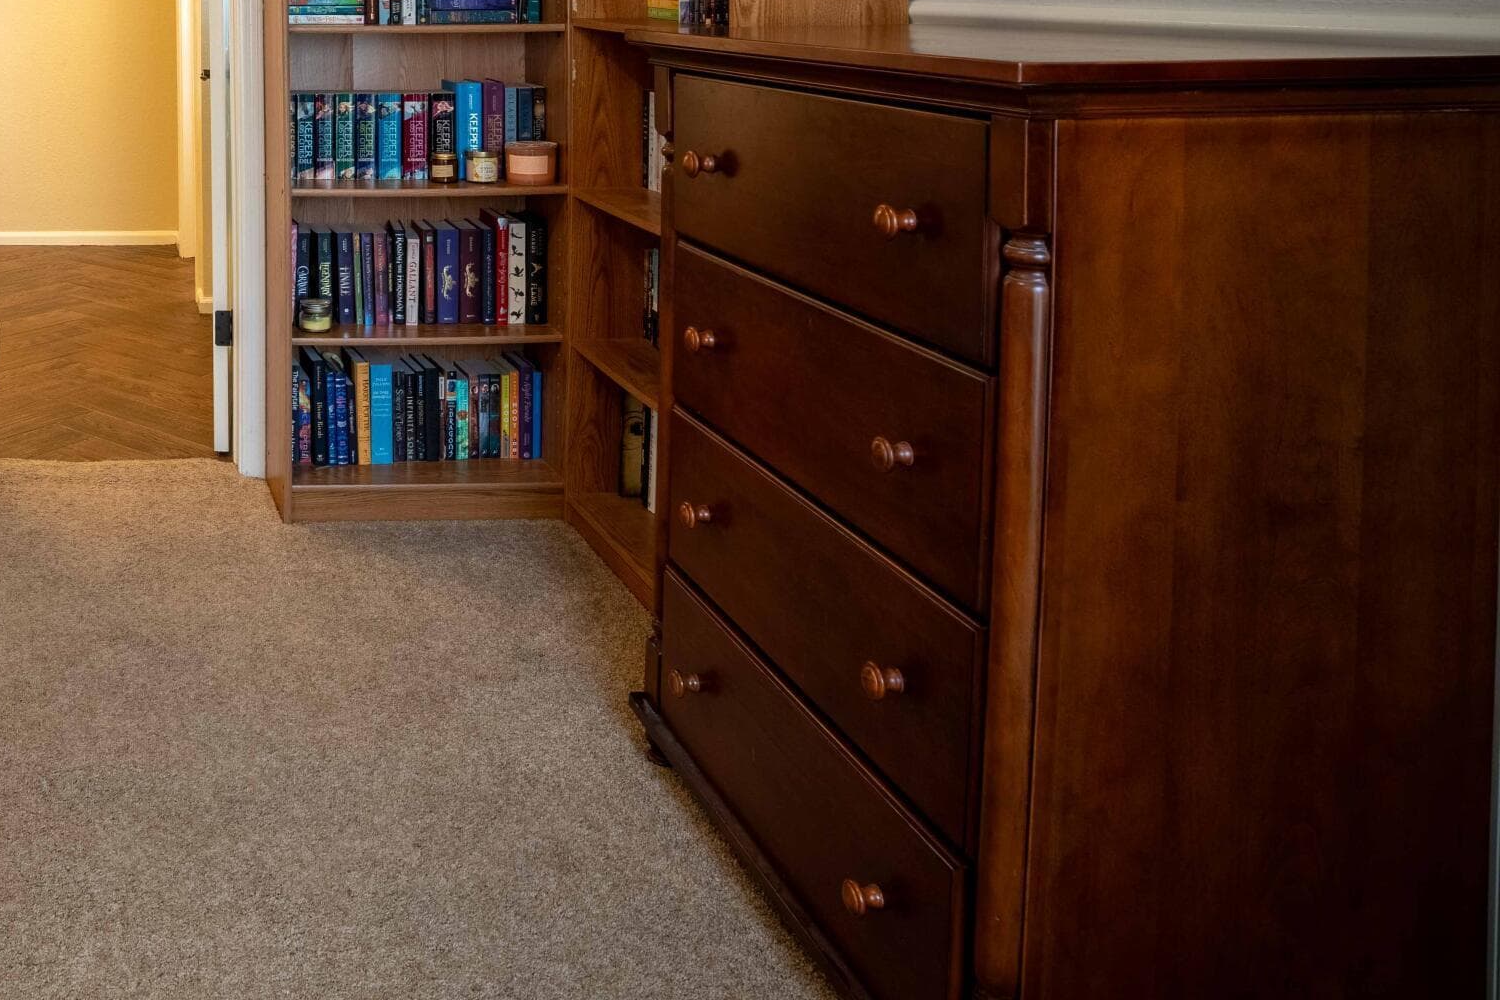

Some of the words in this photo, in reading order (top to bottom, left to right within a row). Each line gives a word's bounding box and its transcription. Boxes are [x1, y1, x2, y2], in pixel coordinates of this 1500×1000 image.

[304, 121, 313, 158] KEEPER
[323, 120, 332, 157] KEEPER
[343, 120, 353, 157] KEEPER
[365, 120, 374, 157] KEEPER
[389, 120, 397, 156] KEEPER
[415, 120, 424, 156] KEEPER
[493, 113, 502, 152] KEEPE
[297, 265, 310, 296] CARAVAL
[319, 262, 332, 297] LEGENDARY
[339, 266, 351, 297] FINALE
[407, 261, 417, 303] GALLANT
[530, 282, 538, 306] FLAME
[522, 381, 532, 399] Night
[362, 404, 370, 432] POTTER
[406, 395, 414, 433] INFINITY
